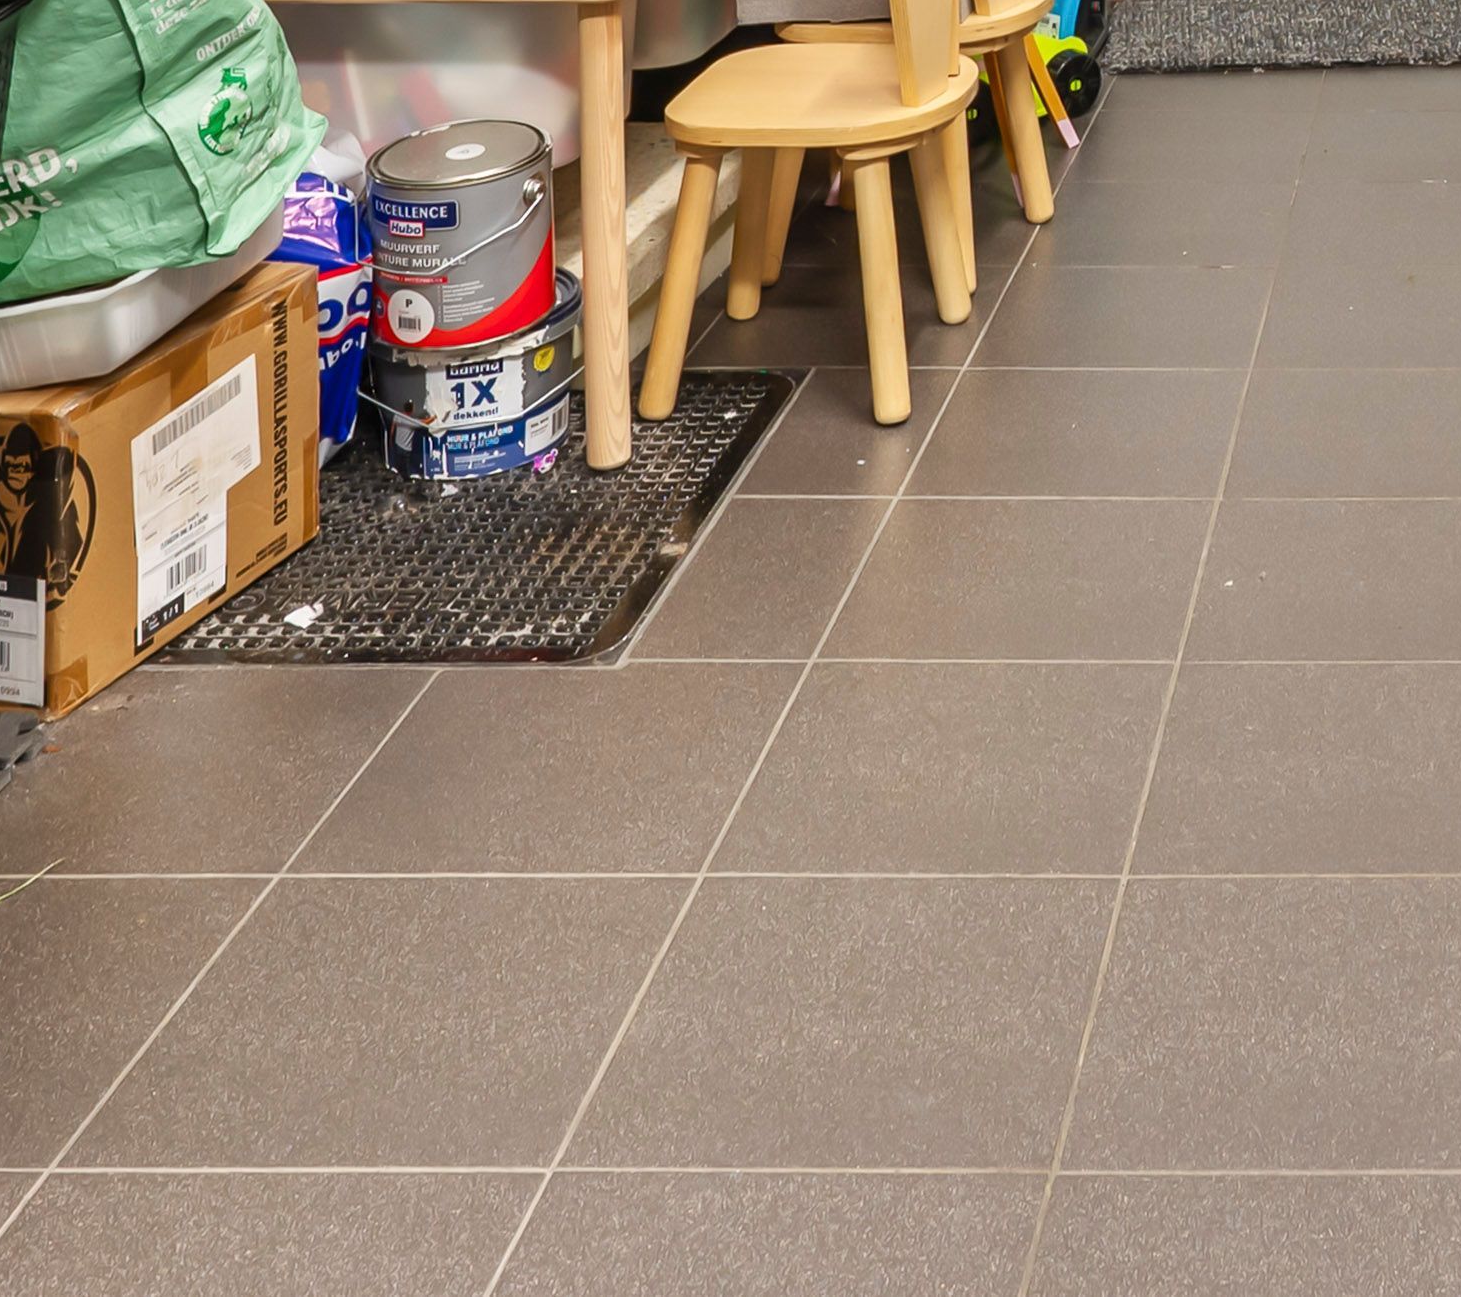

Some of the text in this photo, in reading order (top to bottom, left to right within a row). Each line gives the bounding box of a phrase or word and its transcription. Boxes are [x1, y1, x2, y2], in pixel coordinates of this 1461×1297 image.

[375, 199, 448, 218] EXCELLENCE
[391, 222, 422, 236] Hubo
[380, 239, 440, 254] MUURVERF
[405, 298, 413, 308] P
[271, 299, 289, 527] WWW.GORILLASPORTS.EU
